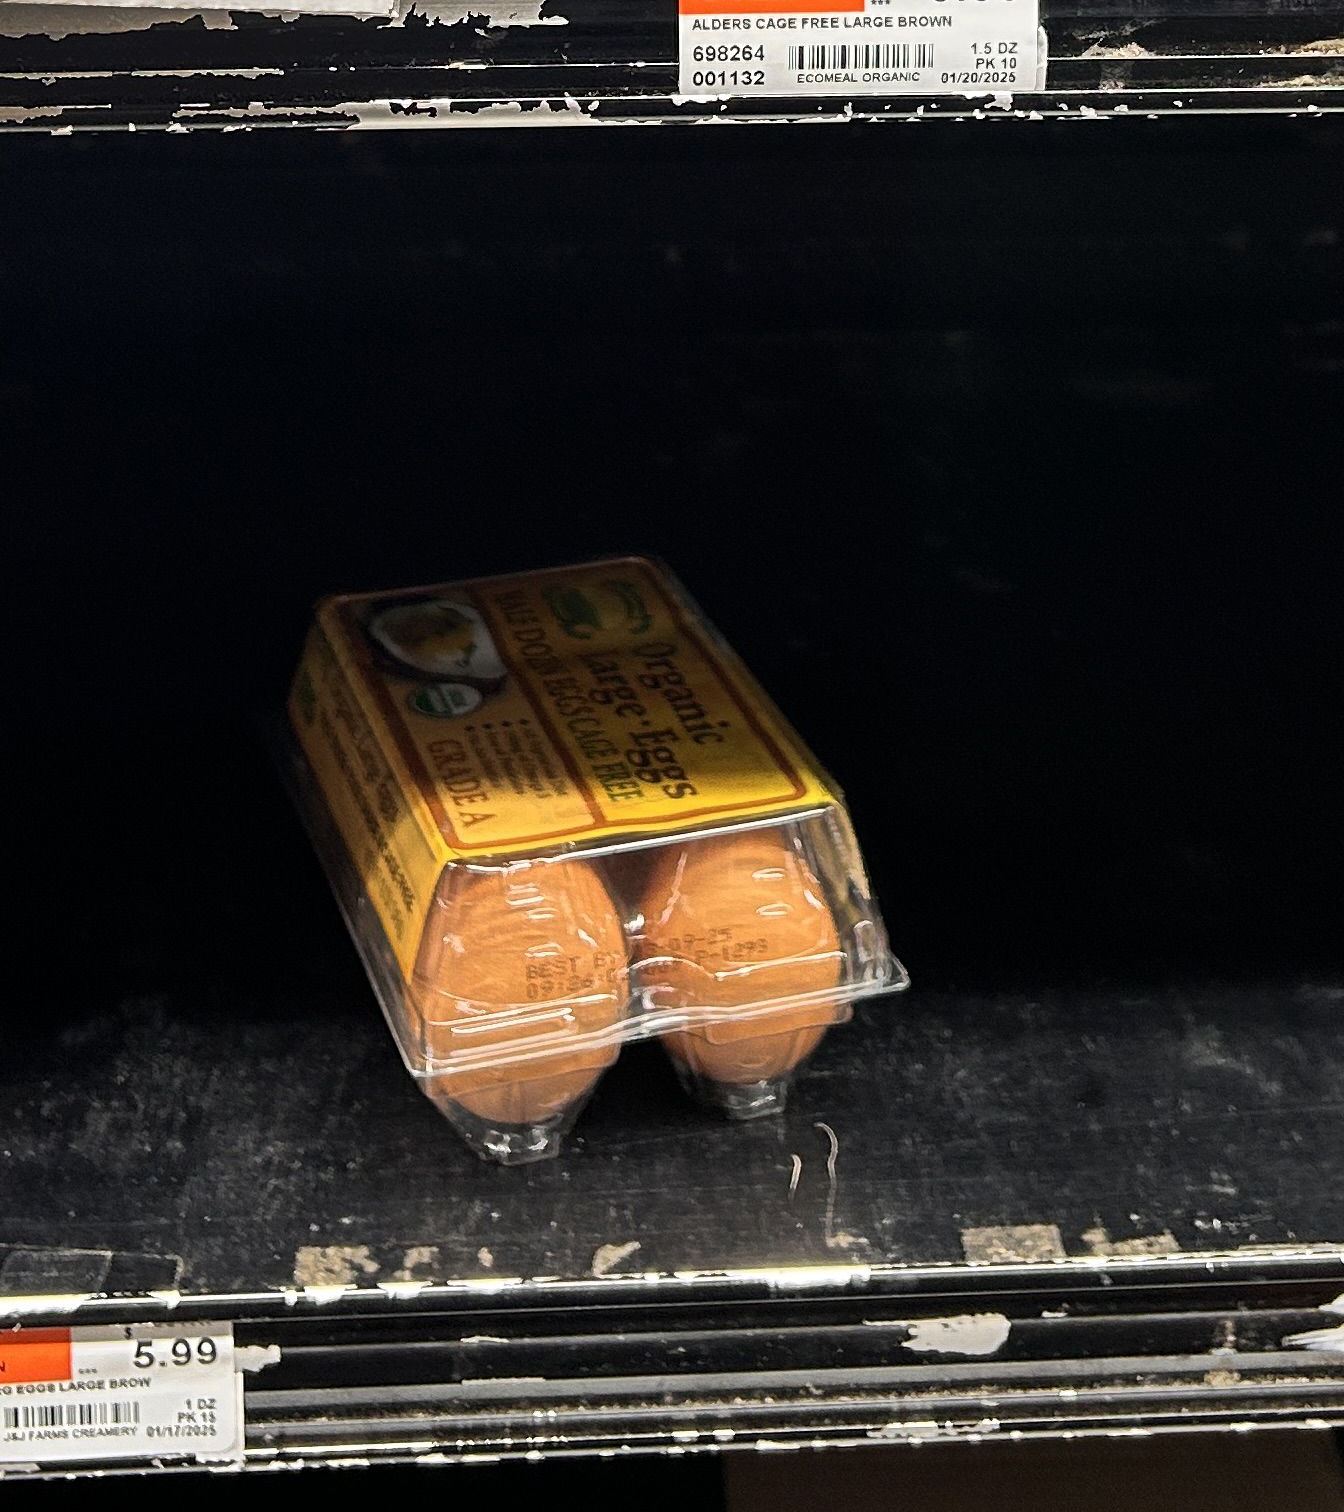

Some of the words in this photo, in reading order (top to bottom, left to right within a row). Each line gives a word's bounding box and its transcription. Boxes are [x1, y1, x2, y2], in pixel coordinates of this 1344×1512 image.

[692, 18, 751, 30] ALDERS
[756, 18, 797, 29] CAGE
[802, 17, 839, 29] FREE
[844, 17, 893, 28] LARGE
[898, 16, 953, 27] BROWN
[693, 45, 765, 62] 698264
[970, 42, 992, 55] 1.5
[998, 42, 1018, 54] DZ
[976, 58, 996, 69] PK
[1001, 58, 1017, 69] 10
[692, 70, 765, 86] 001132
[797, 73, 858, 84] ECOMEAL
[862, 72, 921, 82] ORGANIC
[941, 72, 1016, 83] 01/20/2025
[632, 641, 726, 746] Organic
[576, 648, 646, 719] Large
[628, 728, 697, 799] Eggs
[568, 716, 615, 758] CAGE
[593, 762, 644, 801] FREE
[428, 739, 488, 804] GRADE
[462, 808, 498, 826] A
[525, 955, 579, 980] BEST
[133, 1338, 217, 1368] 5.99
[59, 1378, 105, 1392] LARGE
[109, 1377, 152, 1389] BROW
[197, 1398, 216, 1410] DZ
[177, 1412, 196, 1423] PK
[28, 1429, 68, 1441] FARMS
[72, 1426, 137, 1439] CREAMERY
